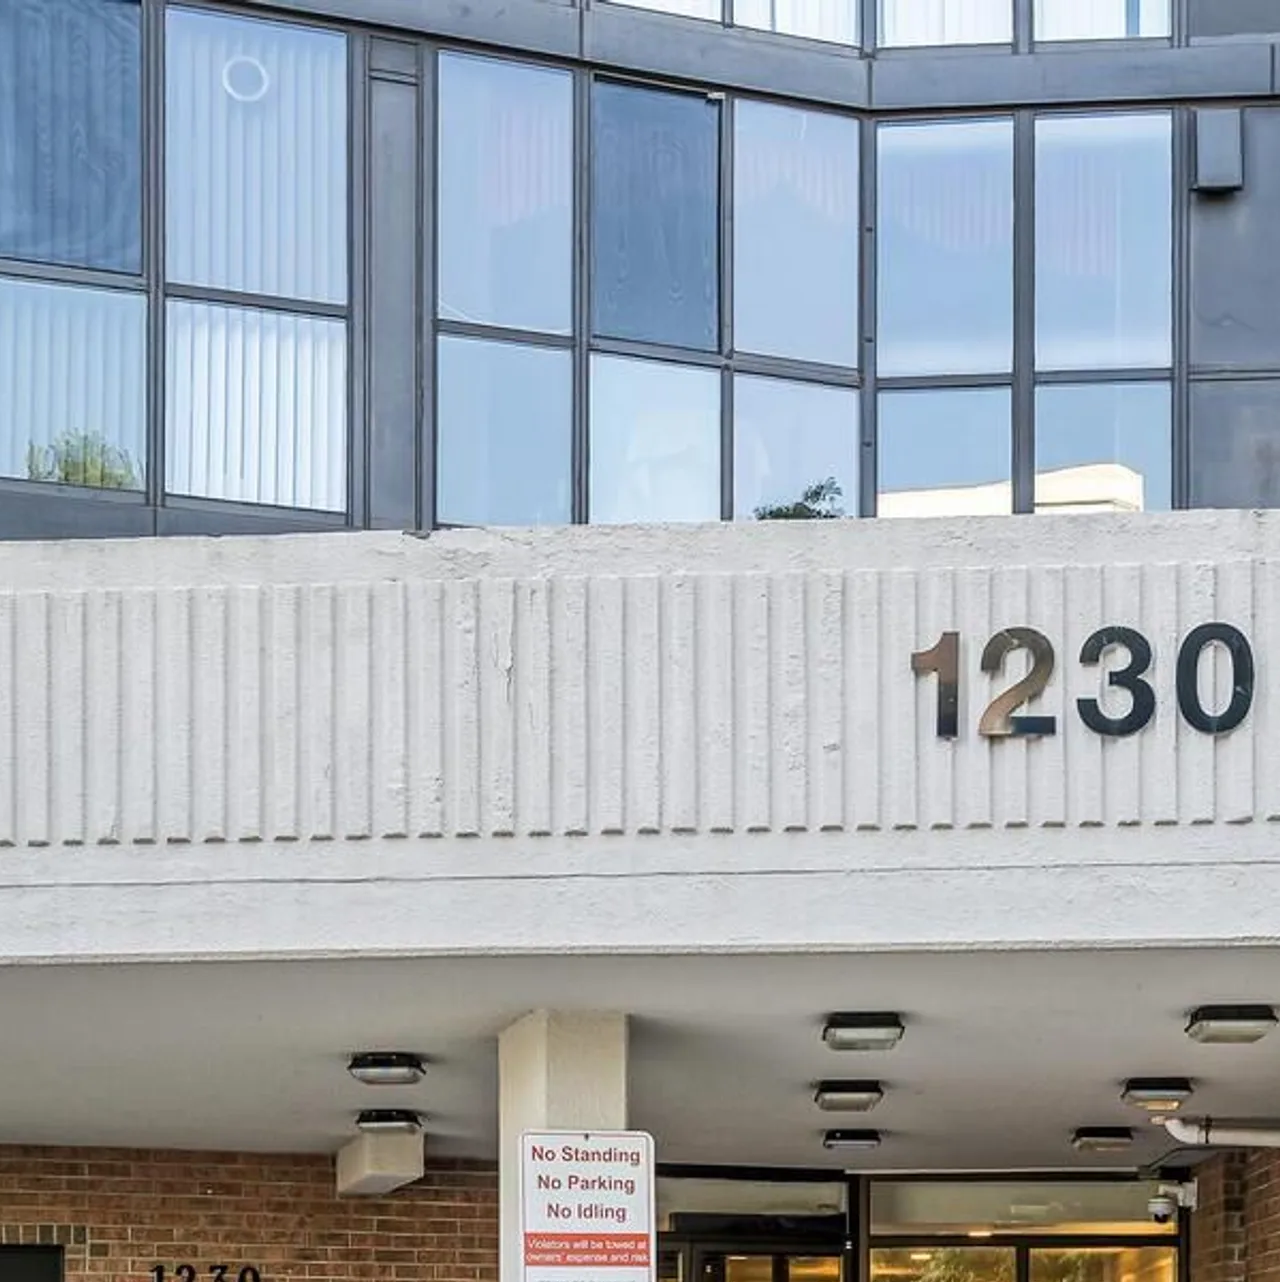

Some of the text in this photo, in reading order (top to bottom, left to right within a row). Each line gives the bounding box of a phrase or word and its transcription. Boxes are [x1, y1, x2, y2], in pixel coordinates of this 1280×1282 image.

[911, 622, 1255, 738] 1230
[532, 1146, 640, 1166] No Standing
[538, 1175, 636, 1195] No Parking
[547, 1204, 627, 1223] No Idling
[527, 1238, 646, 1249] Violators will be towed at
[566, 1253, 608, 1263] expense
[609, 1252, 629, 1262] and
